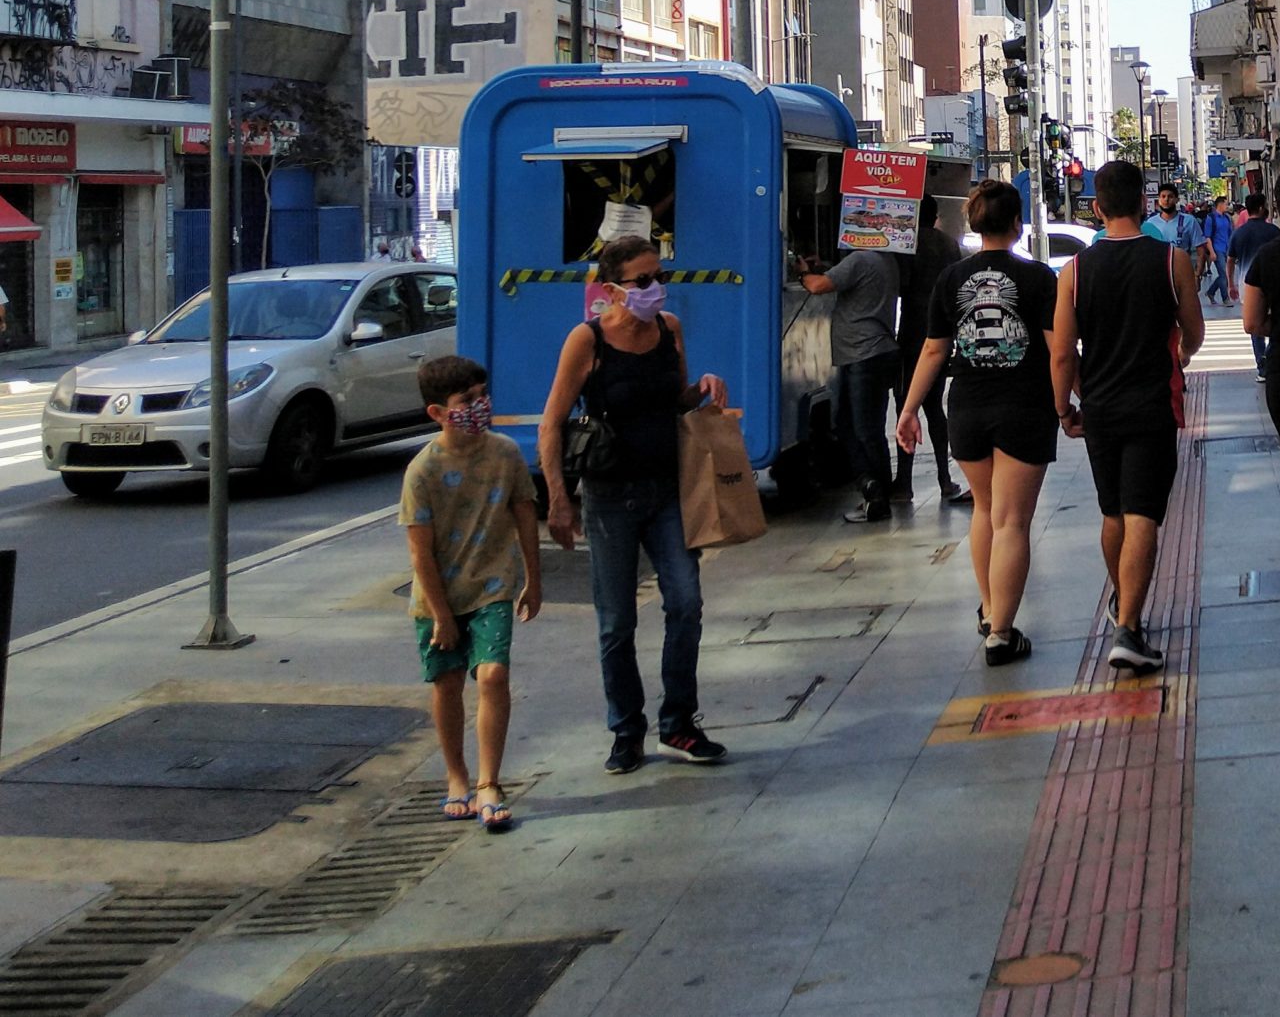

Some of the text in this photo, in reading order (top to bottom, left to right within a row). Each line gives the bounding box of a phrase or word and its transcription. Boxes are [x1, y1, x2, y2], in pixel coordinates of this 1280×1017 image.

[15, 127, 69, 146] MODELO
[854, 151, 917, 167] AQUI TEM
